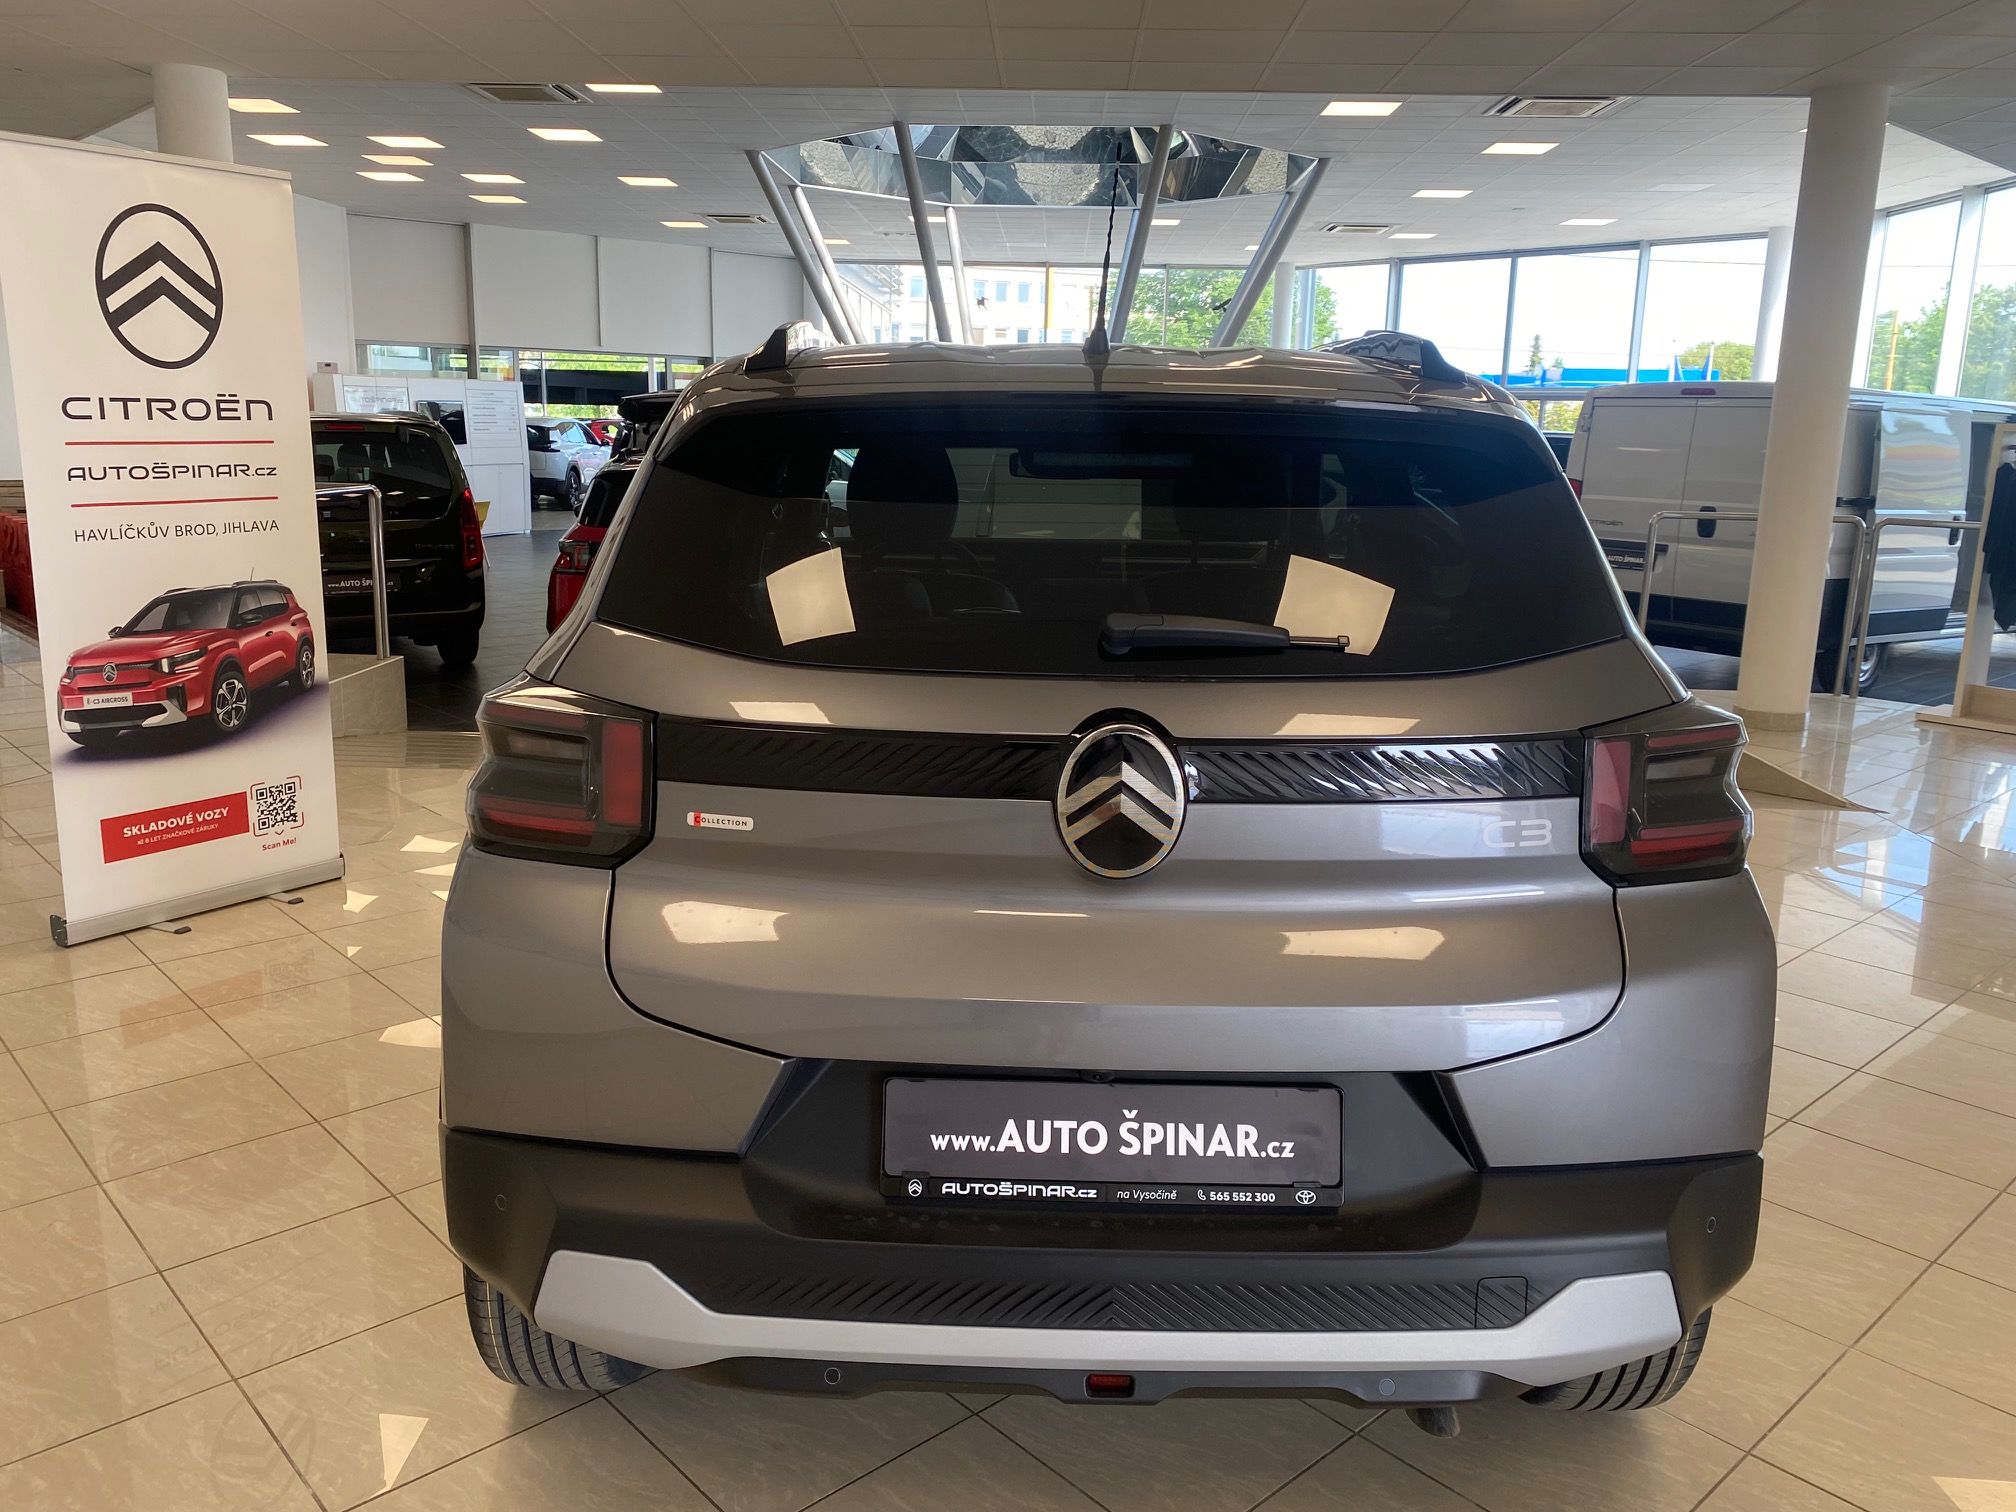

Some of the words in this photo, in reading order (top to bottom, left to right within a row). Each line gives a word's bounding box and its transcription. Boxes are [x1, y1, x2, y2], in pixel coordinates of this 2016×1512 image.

[61, 393, 274, 421] CITROËN
[67, 462, 278, 482] AUTOŠPINAR.cz
[74, 522, 169, 543] HAVLÍČKŮV
[175, 523, 219, 538] BROD,
[222, 519, 280, 535] JIHLAVA
[123, 812, 194, 838] SKLADOVÉ
[196, 807, 230, 823] VOZY
[694, 815, 748, 827] COLLECTION
[150, 834, 161, 843] LET
[262, 841, 281, 851] Scan
[282, 837, 297, 847] Me!
[1483, 819, 1552, 848] C3
[930, 1118, 1109, 1155] www.AUTO
[1118, 1109, 1295, 1158] ŠPINAR.cz
[942, 1181, 1097, 1198] AUTOŠPINAR.cz
[1116, 1190, 1130, 1200] na
[1132, 1188, 1177, 1202] Vysočině
[1209, 1191, 1229, 1202] 565
[1230, 1192, 1252, 1202] 552
[1254, 1192, 1276, 1202] 300
